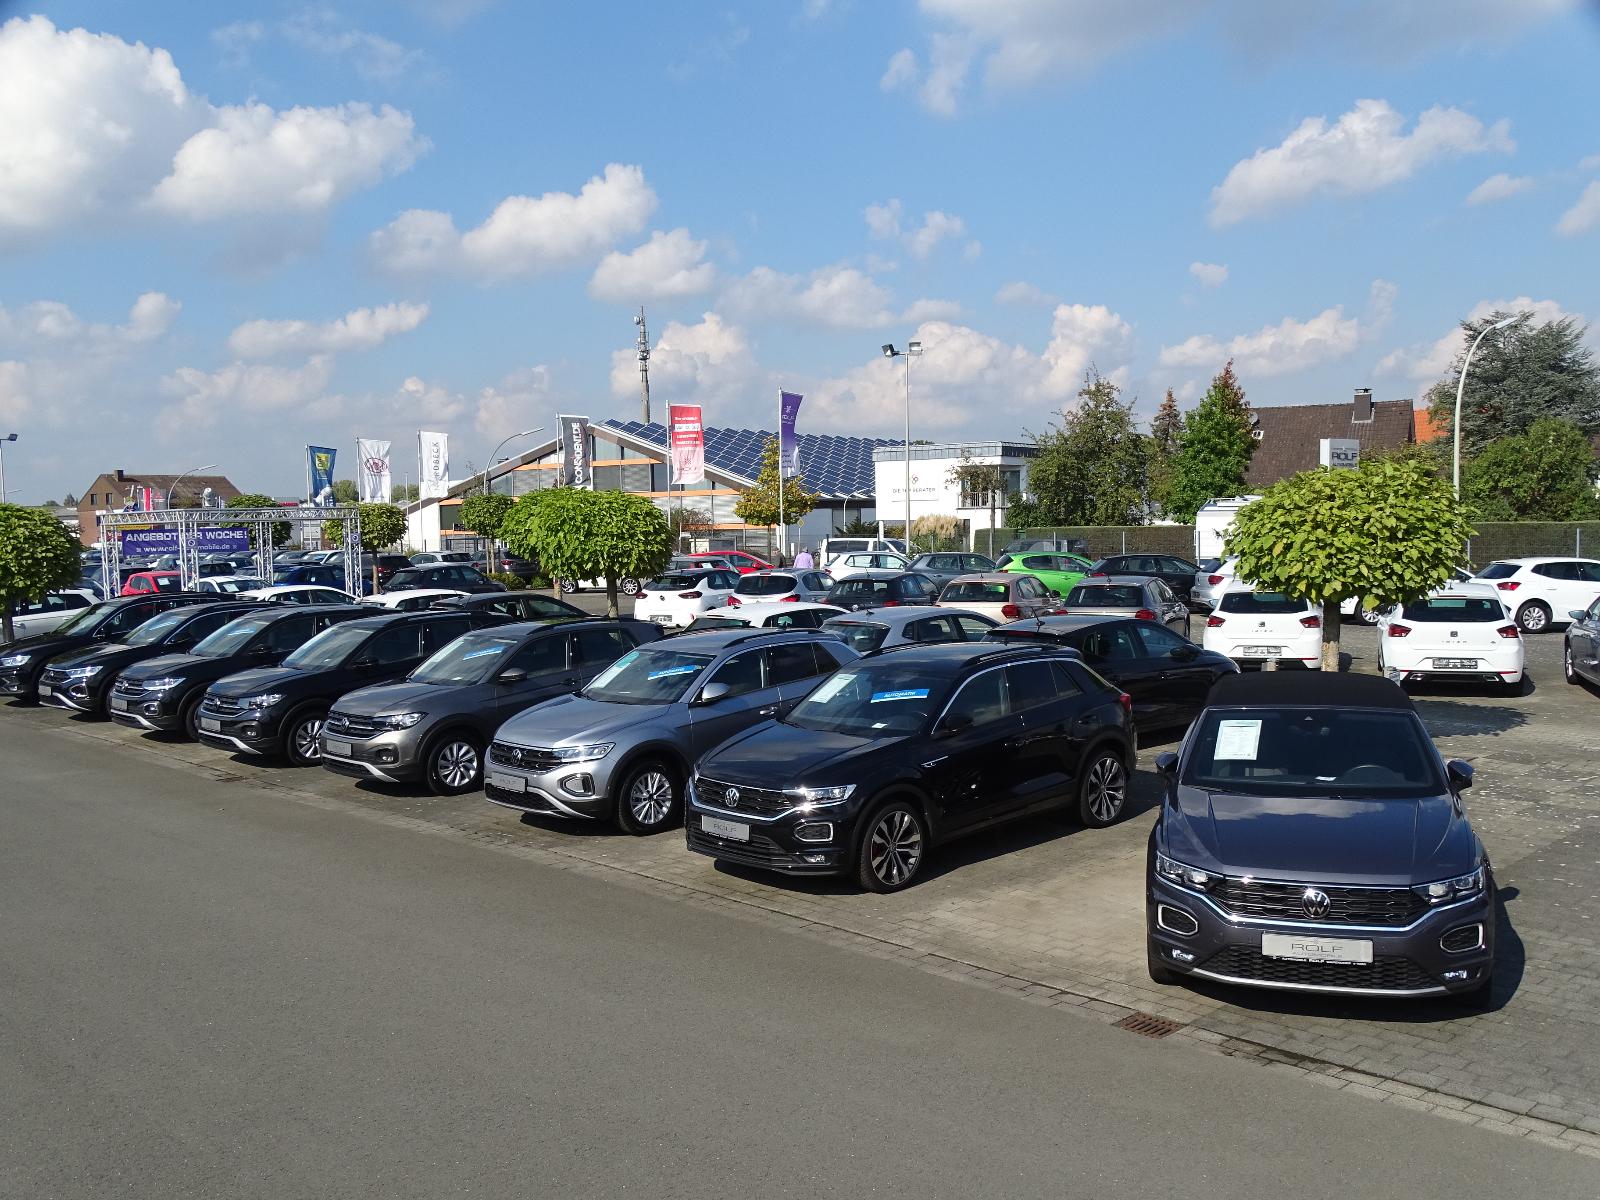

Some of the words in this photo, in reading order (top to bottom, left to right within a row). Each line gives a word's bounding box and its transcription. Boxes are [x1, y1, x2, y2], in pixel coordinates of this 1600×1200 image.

[1331, 451, 1358, 461] ROLF
[125, 532, 178, 542] ANGEBOT
[205, 530, 248, 539] WOCHE!
[1291, 943, 1343, 953] ROLF
